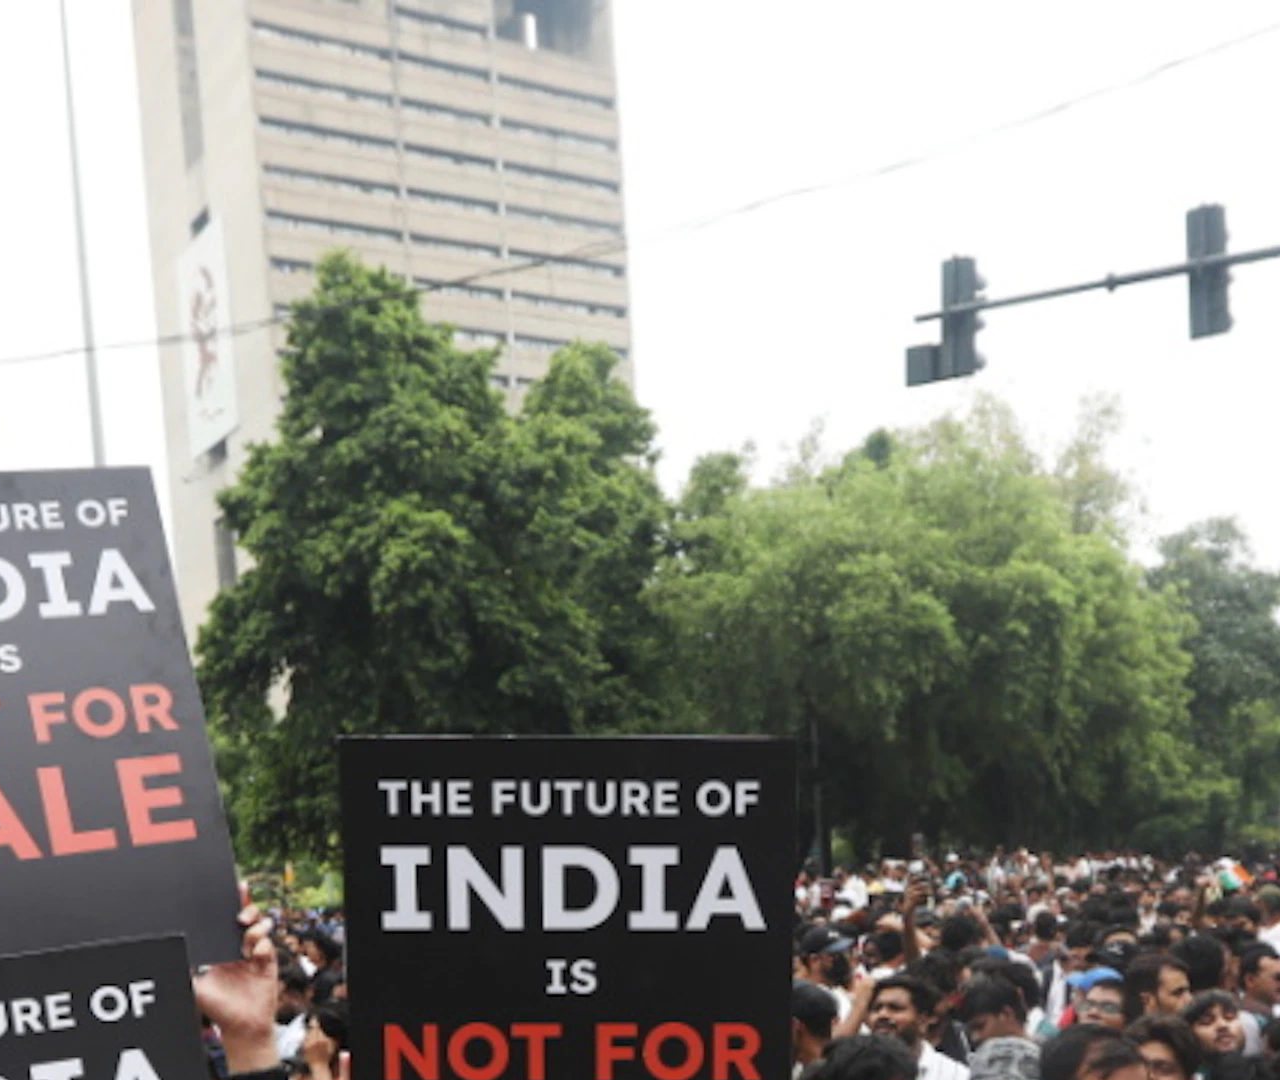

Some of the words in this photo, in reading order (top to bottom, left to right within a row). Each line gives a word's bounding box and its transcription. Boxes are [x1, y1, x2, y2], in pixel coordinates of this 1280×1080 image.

[74, 497, 129, 532] OF
[26, 683, 180, 744] FOR
[379, 780, 474, 816] THE
[491, 780, 680, 816] FUTURE
[695, 780, 760, 817] OF
[380, 845, 767, 931] INDIA
[545, 958, 597, 995] IS
[89, 979, 155, 1022] OF
